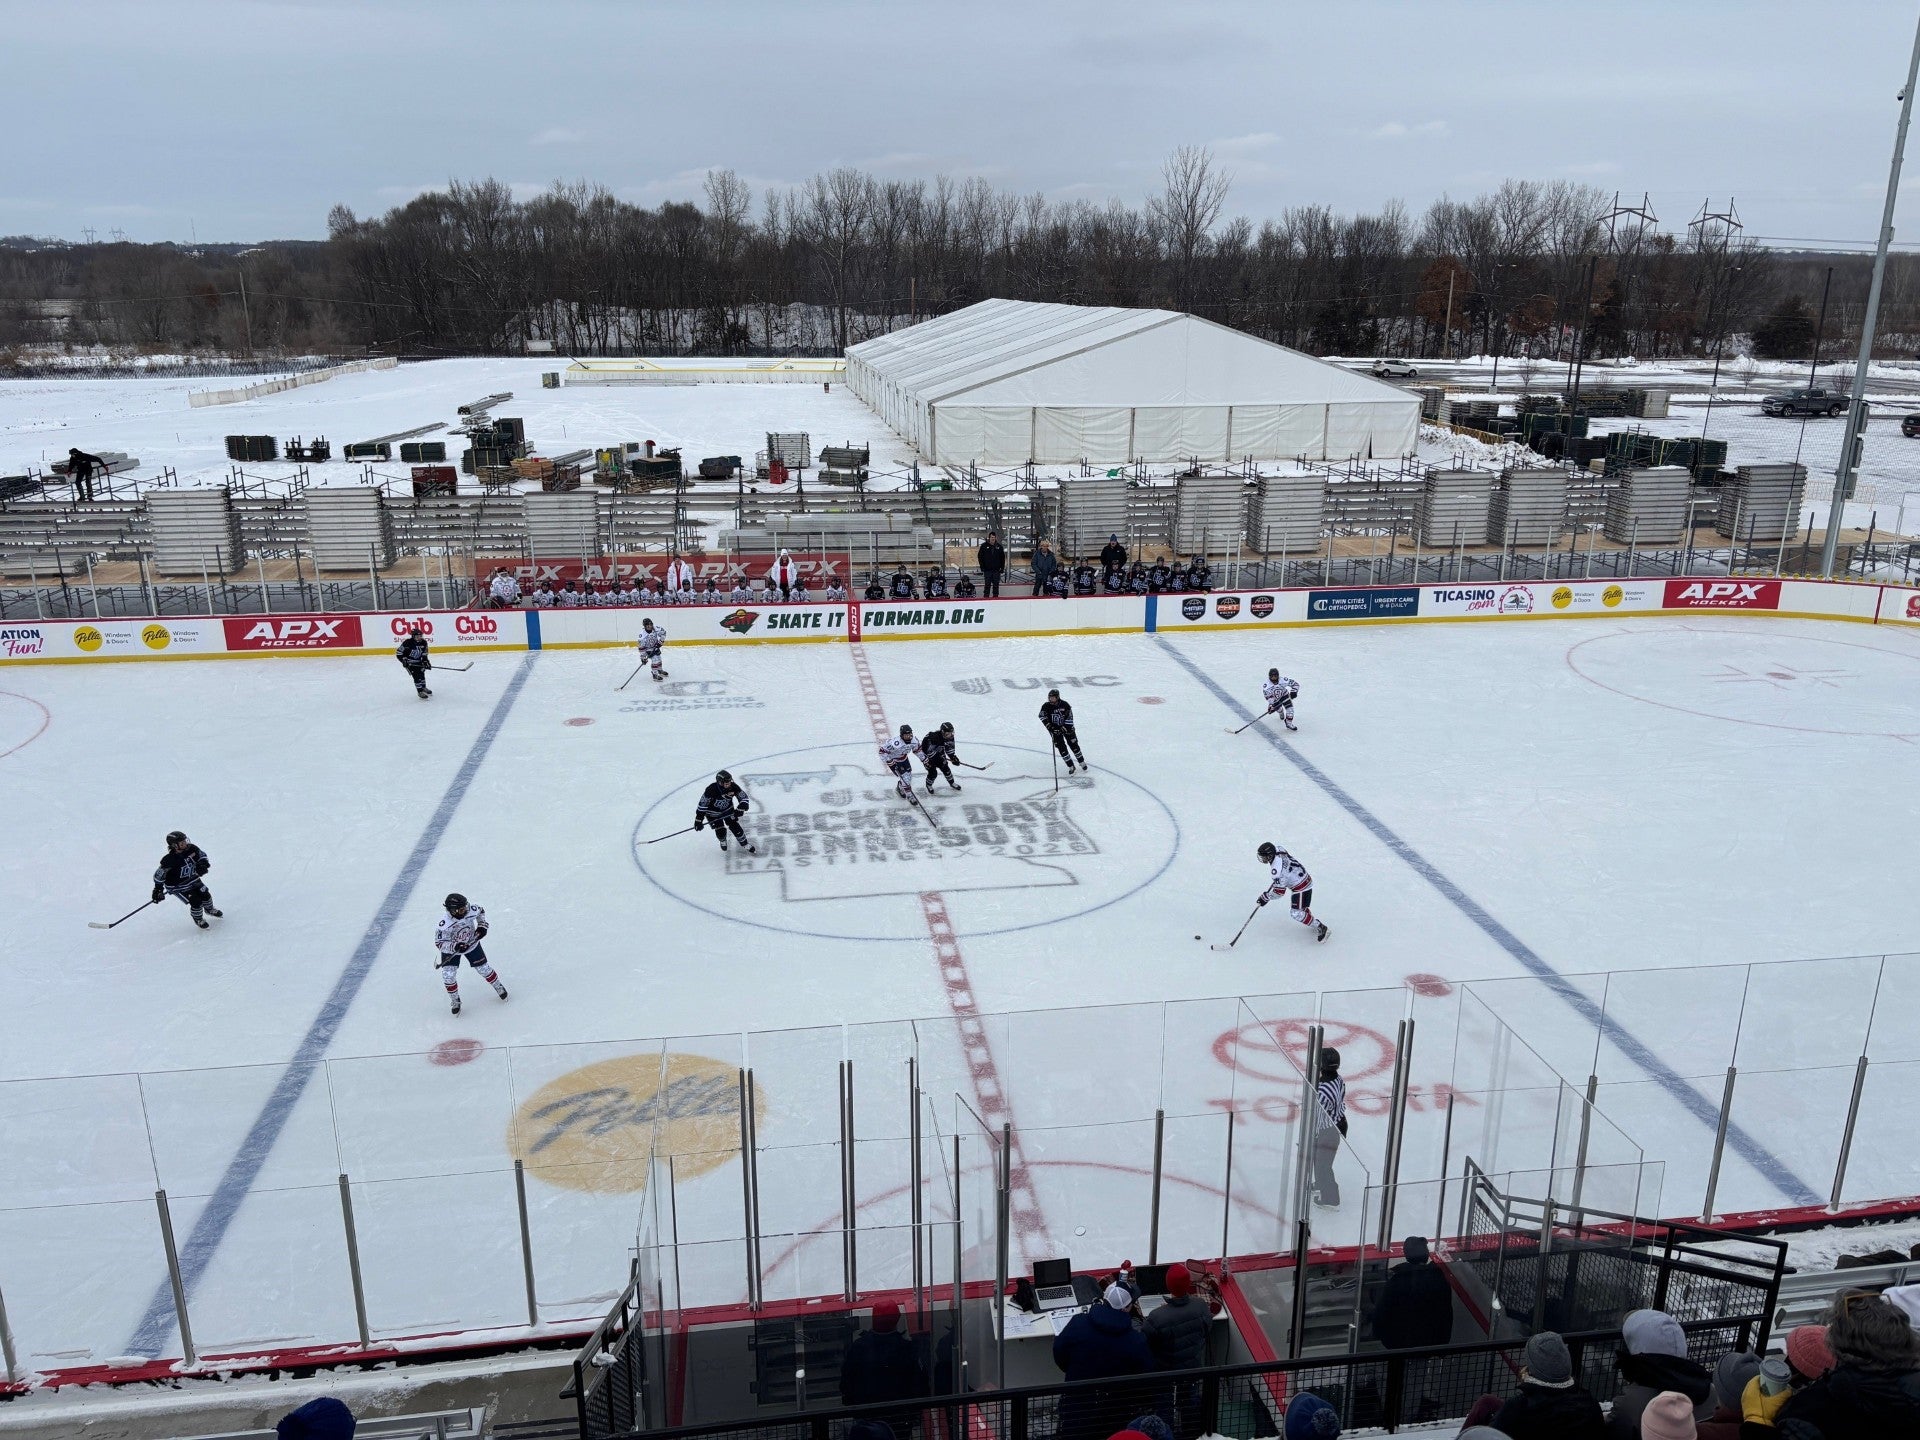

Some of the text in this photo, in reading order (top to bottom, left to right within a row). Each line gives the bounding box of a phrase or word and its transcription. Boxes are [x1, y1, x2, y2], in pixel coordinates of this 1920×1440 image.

[1434, 590, 1495, 602] TICASINO
[1677, 584, 1771, 600] APX
[1465, 600, 1495, 611] .com
[391, 617, 433, 636] Cub
[455, 616, 497, 634] Cub
[767, 608, 985, 629] SKATE IT FORWARD.ORG
[143, 629, 169, 643] Pella
[243, 619, 344, 640] APX
[75, 631, 101, 645] Pella
[260, 638, 330, 647] HOCKEY
[2, 638, 44, 657] Fun!
[1001, 675, 1123, 690] UHC
[618, 702, 766, 713] ORTHOPEDICS
[632, 698, 684, 706] TWIN
[962, 800, 1060, 825] DAY
[734, 850, 943, 870] HASTINGS
[1208, 1083, 1480, 1126] TOOTA
